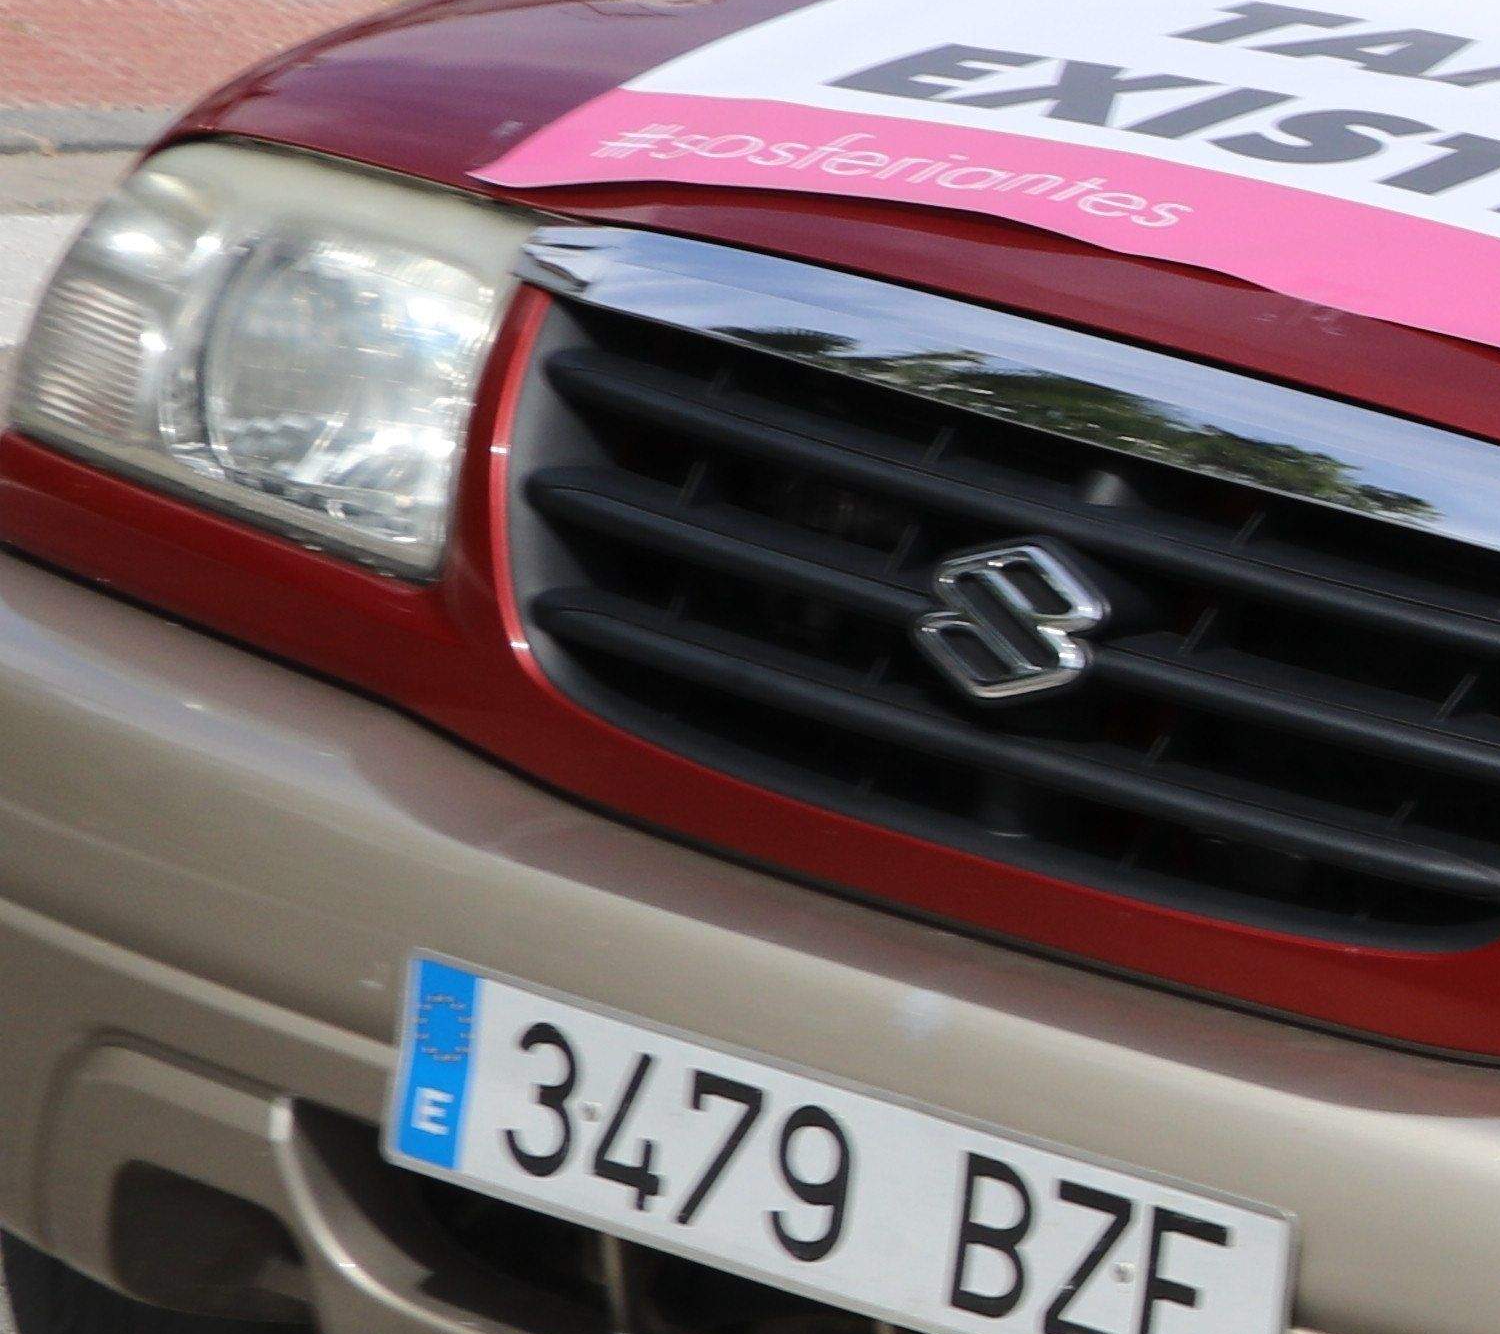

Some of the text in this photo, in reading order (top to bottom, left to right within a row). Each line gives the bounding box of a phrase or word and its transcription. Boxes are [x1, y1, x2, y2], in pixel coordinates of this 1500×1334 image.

[594, 123, 1194, 231] #sosferiantes
[411, 1085, 452, 1137] E
[501, 1021, 853, 1264] 3479
